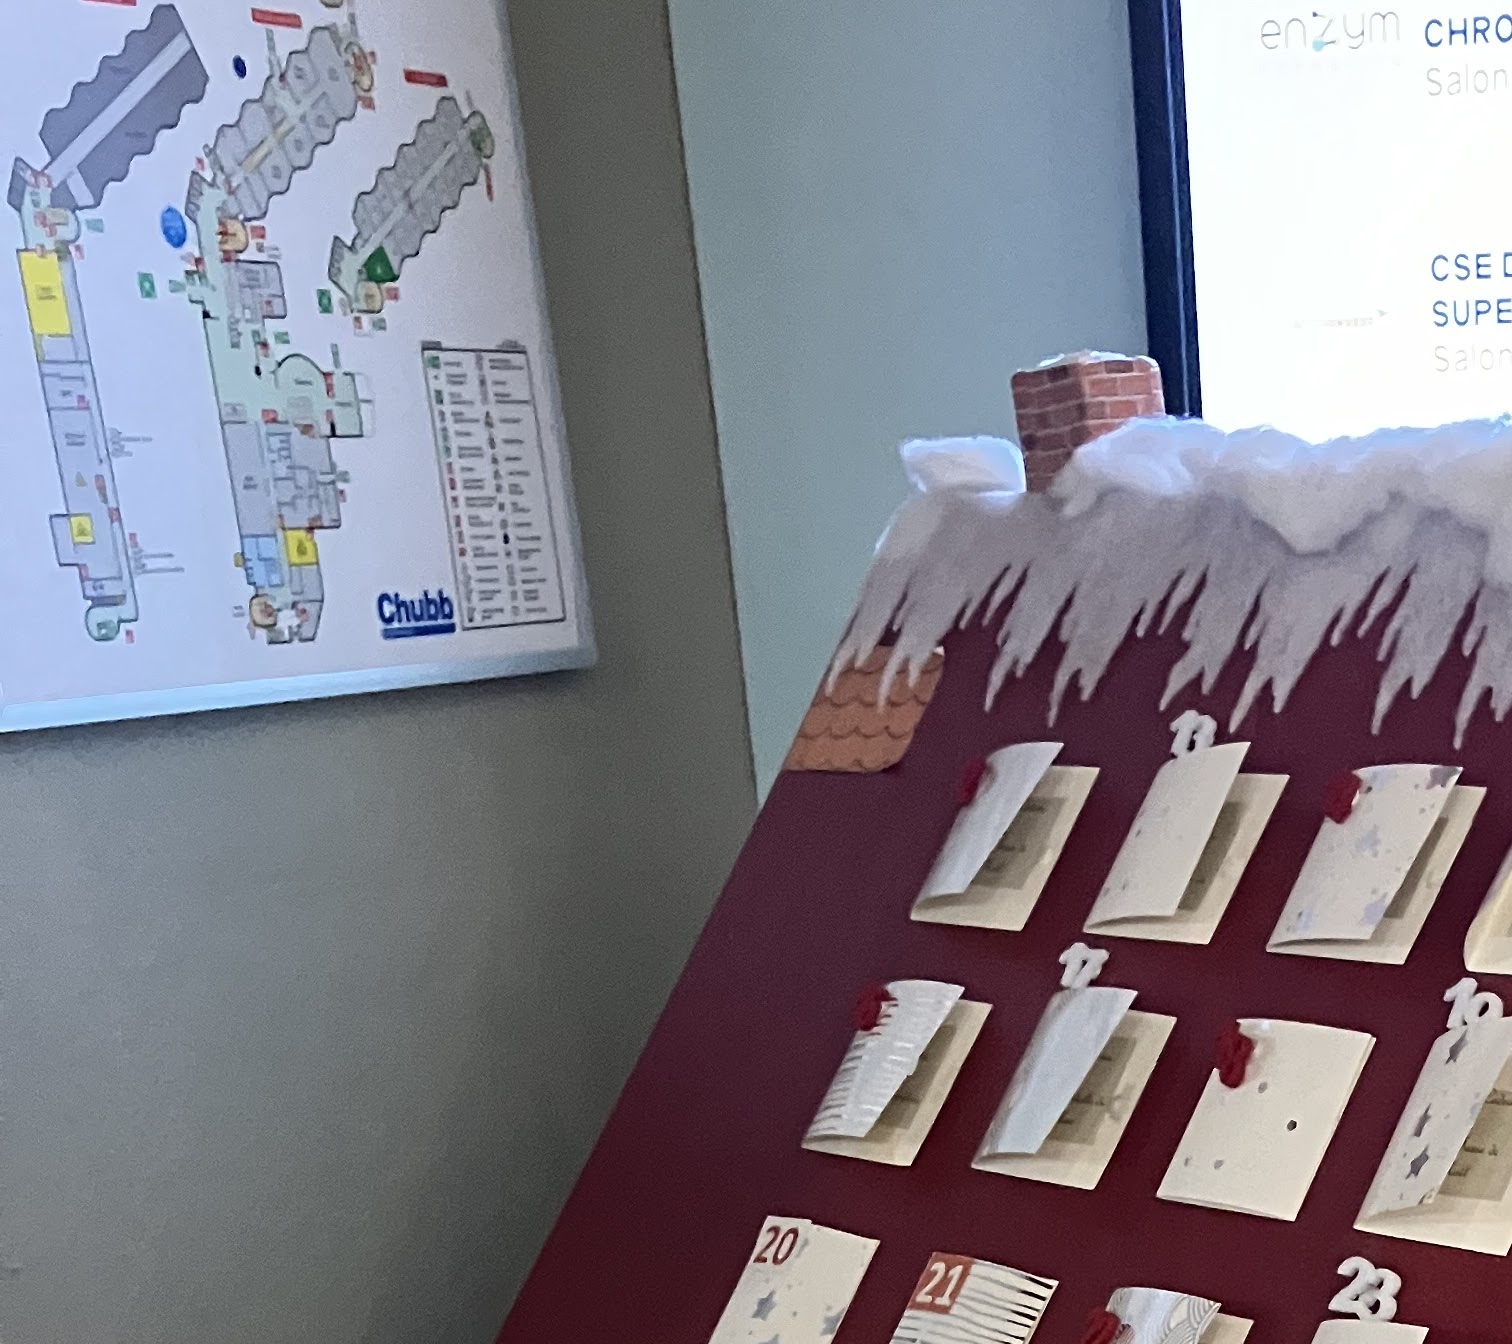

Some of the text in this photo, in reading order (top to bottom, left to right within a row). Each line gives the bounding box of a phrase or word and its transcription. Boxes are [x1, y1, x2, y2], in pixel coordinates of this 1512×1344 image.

[1425, 61, 1509, 97] Salon
[1431, 253, 1493, 282] CSE
[378, 589, 454, 625] Chubb
[753, 1225, 799, 1266] 20
[916, 1261, 964, 1307] 21
[1328, 1256, 1402, 1321] 23
